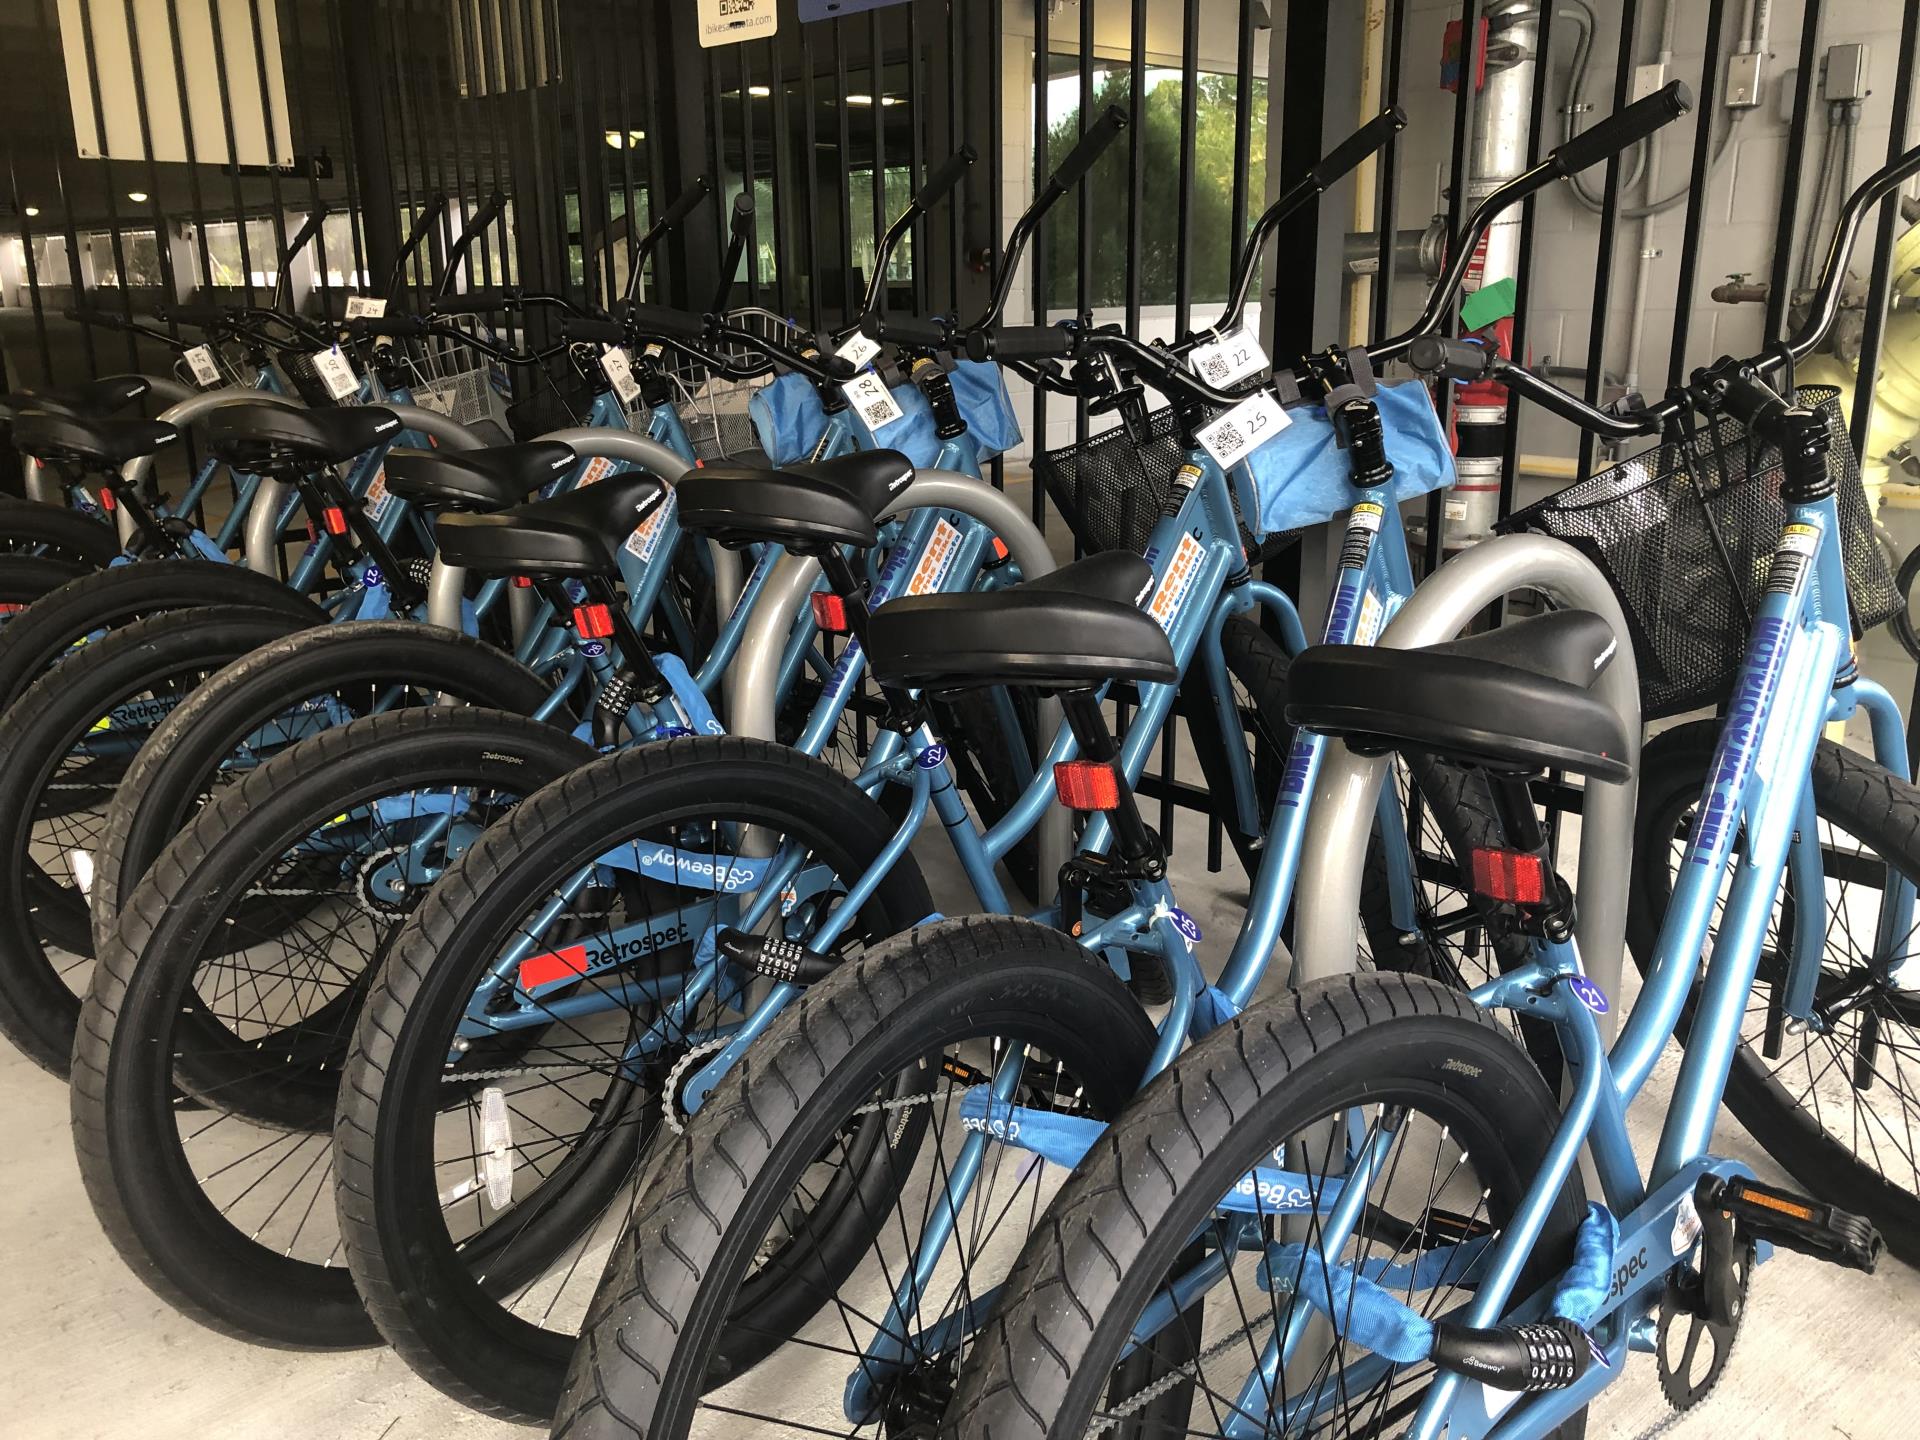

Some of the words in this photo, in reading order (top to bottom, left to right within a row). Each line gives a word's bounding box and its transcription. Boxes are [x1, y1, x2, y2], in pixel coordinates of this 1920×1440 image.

[851, 345, 867, 360] 26
[1233, 349, 1251, 366] 22
[858, 379, 880, 397] 28
[1246, 411, 1267, 435] 25
[1192, 526, 1203, 542] C
[910, 523, 947, 594] Rent
[935, 530, 954, 563] Bike
[932, 534, 960, 589] Sarasota
[366, 569, 378, 584] 27
[1152, 537, 1192, 614] Rent
[1160, 584, 1179, 617] This
[1178, 544, 1198, 580] Bike
[1163, 611, 1174, 632] ike
[1174, 550, 1204, 606] Sarasota
[481, 751, 524, 765] Retrospec
[927, 746, 941, 764] 22
[1181, 915, 1196, 939] 25
[584, 921, 689, 971] Retrospec
[1581, 987, 1605, 1006] 21
